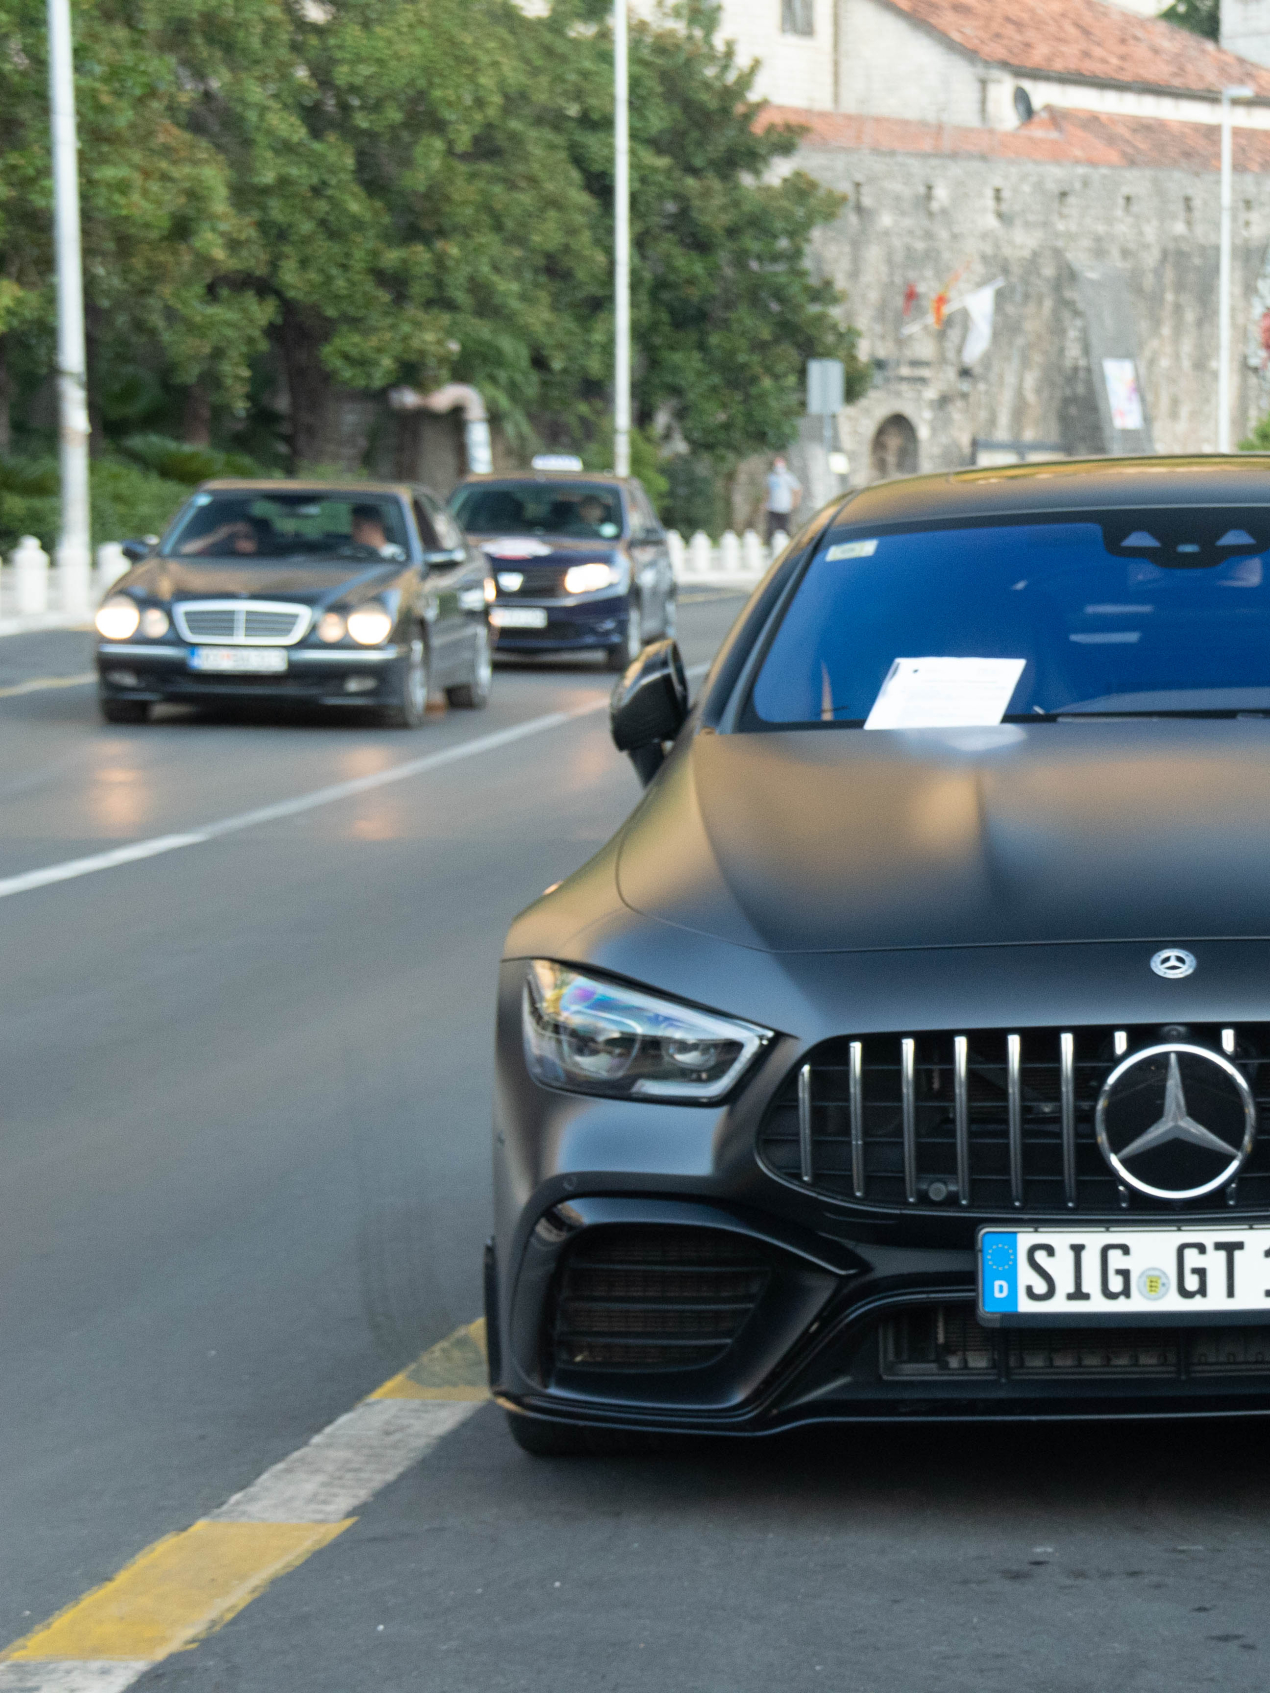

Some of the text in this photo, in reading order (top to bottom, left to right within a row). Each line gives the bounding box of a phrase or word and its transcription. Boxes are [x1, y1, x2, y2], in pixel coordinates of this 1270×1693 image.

[993, 1280, 1008, 1298] D
[1025, 1243, 1131, 1302] SIG
[1176, 1241, 1245, 1300] GT
